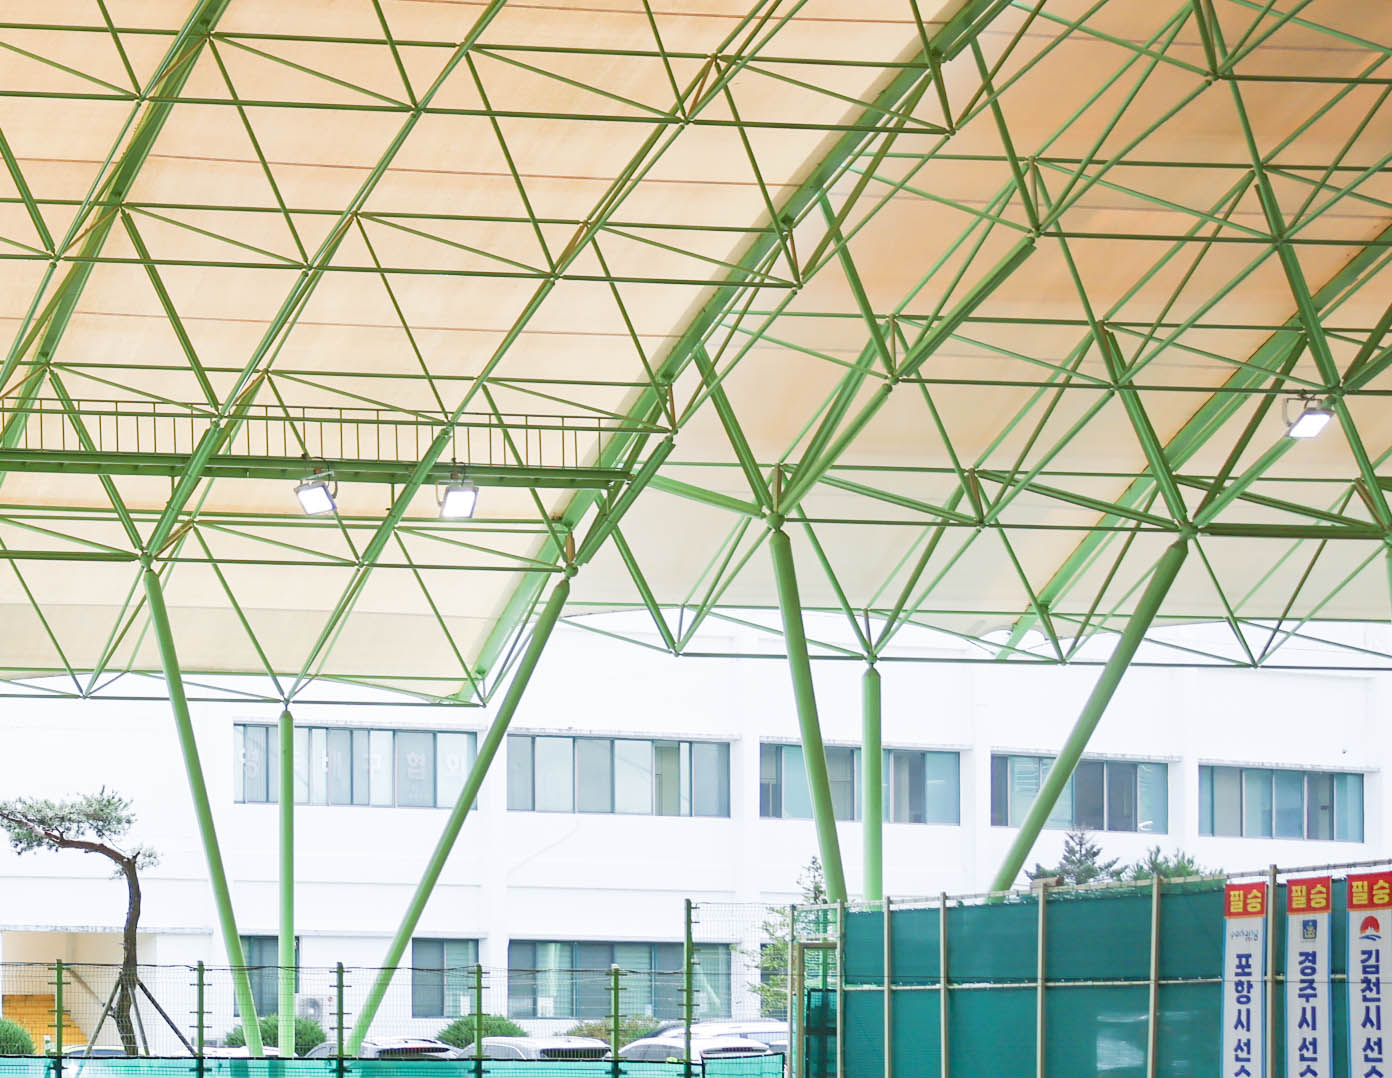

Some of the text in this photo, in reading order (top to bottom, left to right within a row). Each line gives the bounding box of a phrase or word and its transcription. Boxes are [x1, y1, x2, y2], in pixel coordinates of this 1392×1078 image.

[1229, 888, 1263, 913] 필승
[1290, 884, 1328, 908] 필승
[1351, 879, 1391, 905] 필승
[1234, 952, 1253, 1033] 포항시
[1298, 951, 1318, 1031] 경주시
[1359, 949, 1382, 1031] 김천시
